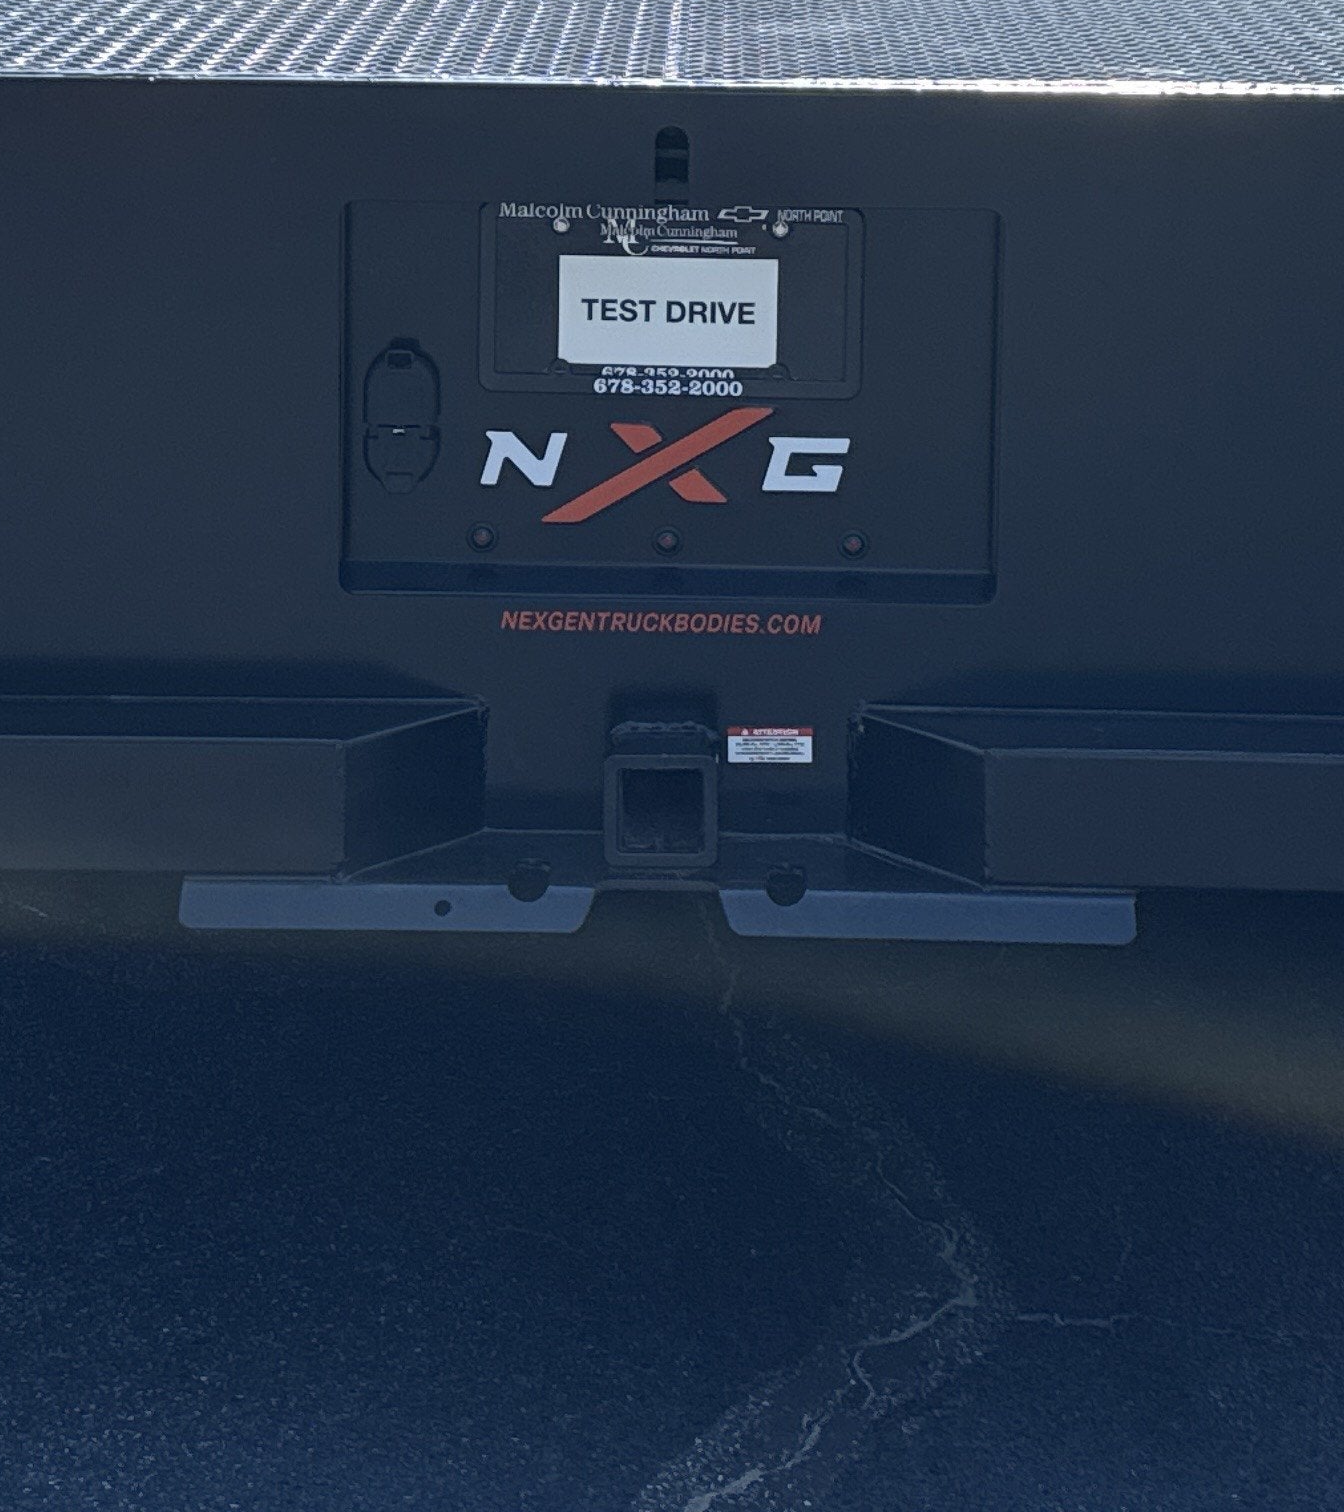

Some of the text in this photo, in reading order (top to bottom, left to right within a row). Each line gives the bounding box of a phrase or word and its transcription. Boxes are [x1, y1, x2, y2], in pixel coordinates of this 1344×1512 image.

[498, 202, 844, 225] Malcolm Cunningham NORTH POINT
[657, 223, 738, 240] Cunningham
[580, 298, 756, 325] TEST DRIVE
[593, 377, 744, 397] 678-352-2000
[500, 609, 823, 635] NEXGENTRUCKBODIES.COM
